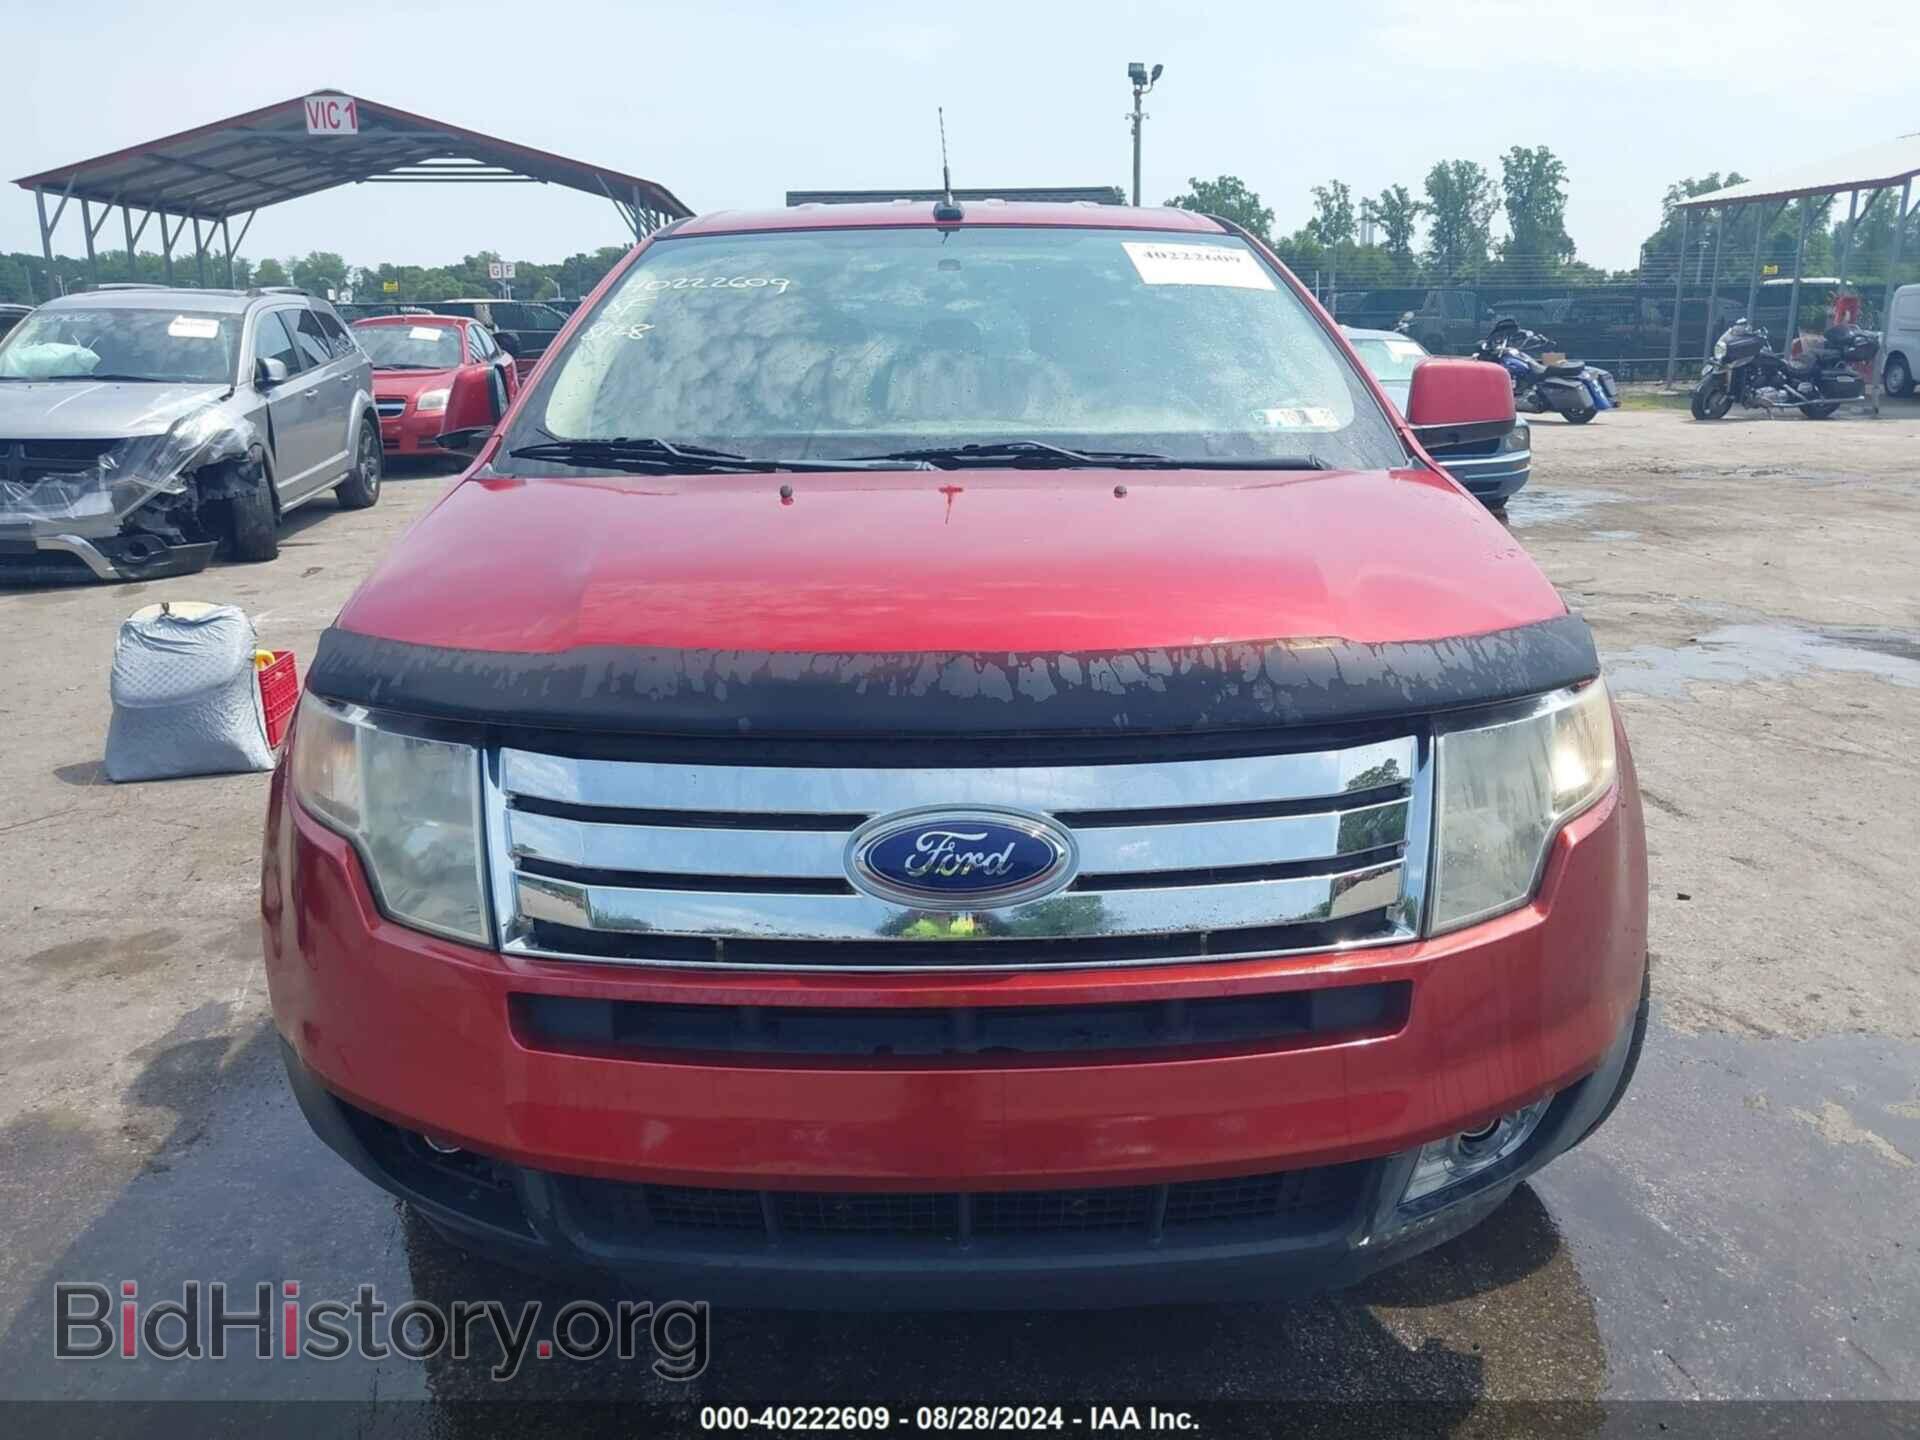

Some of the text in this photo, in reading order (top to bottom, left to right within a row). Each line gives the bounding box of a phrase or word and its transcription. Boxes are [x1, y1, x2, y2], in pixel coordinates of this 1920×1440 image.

[307, 101, 356, 129] VIC 1
[904, 831, 1016, 877] Ford
